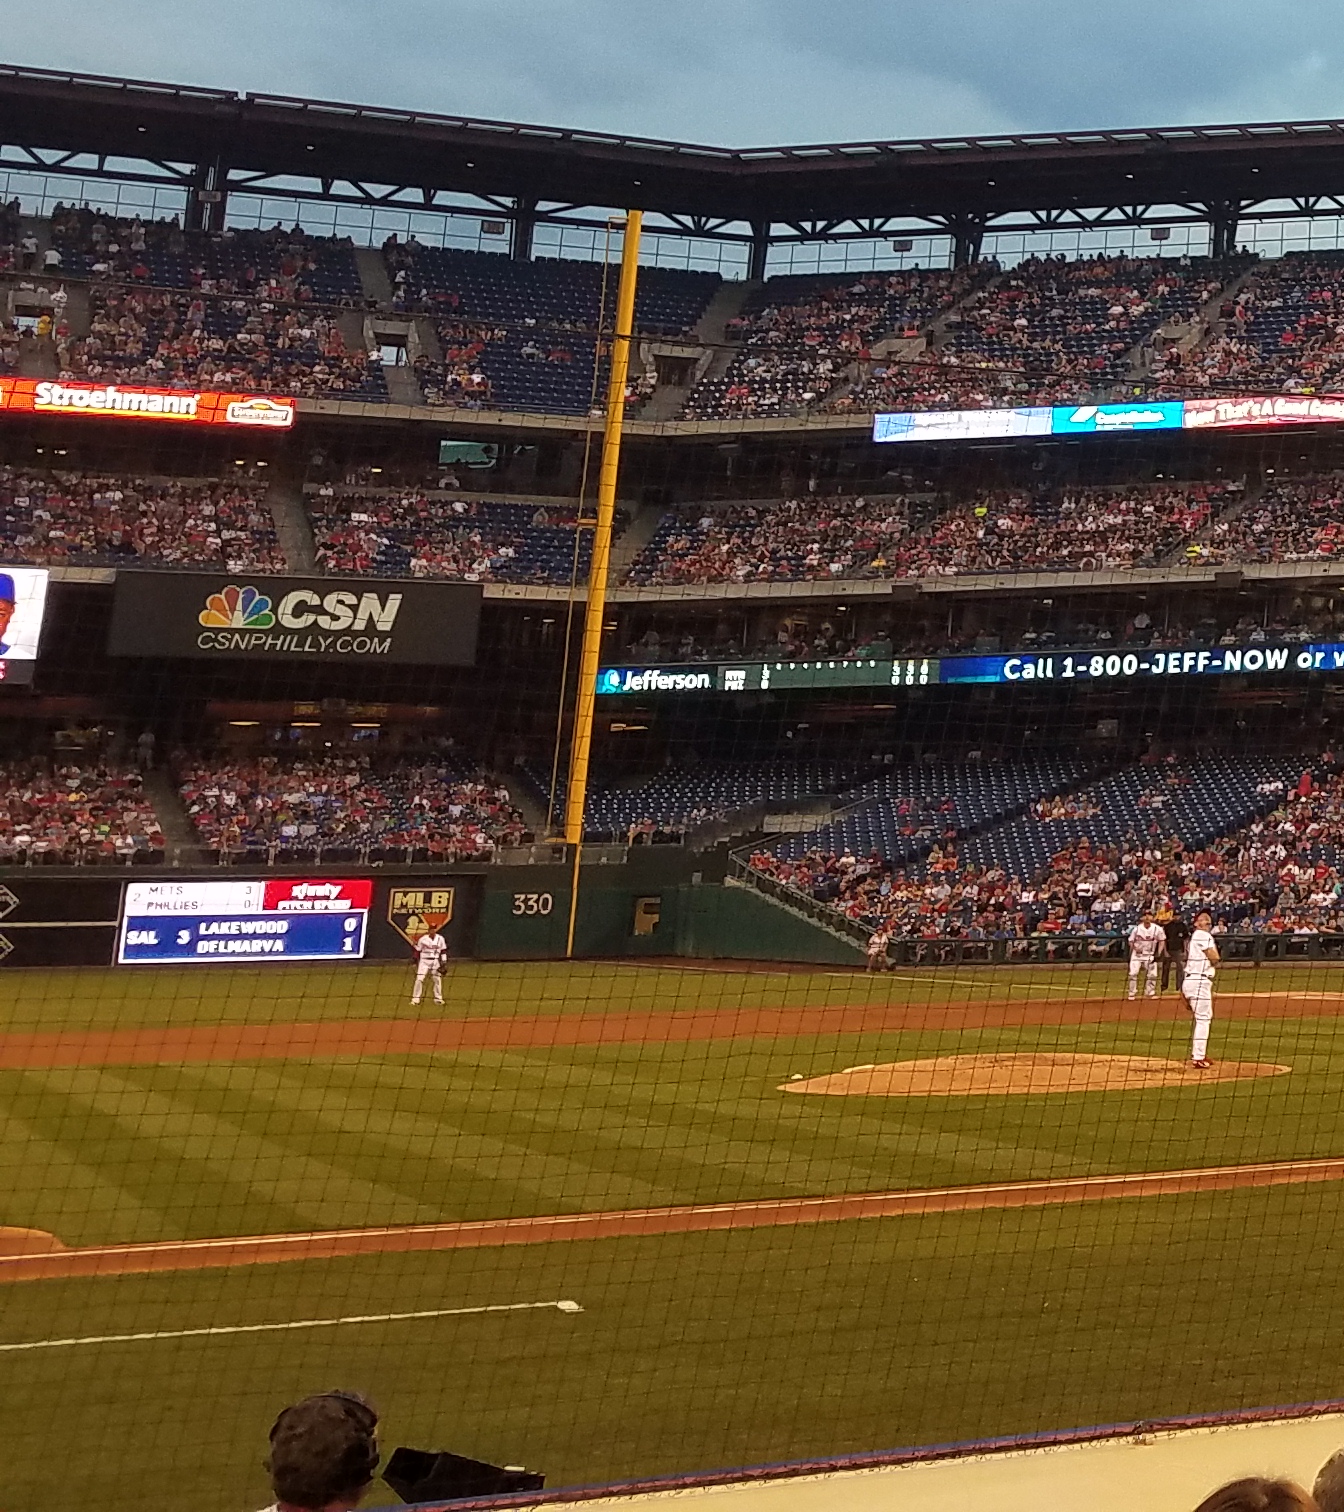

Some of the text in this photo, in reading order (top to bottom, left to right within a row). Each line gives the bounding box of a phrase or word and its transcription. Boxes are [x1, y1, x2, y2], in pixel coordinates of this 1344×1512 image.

[34, 381, 199, 415] Stroehmann
[277, 589, 402, 632] CSN
[197, 631, 391, 655] CSNPHILLY.COM
[1003, 656, 1054, 681] Call
[1061, 648, 1289, 679] 1-800-JEFF-NOW
[1297, 646, 1326, 669] or
[622, 670, 710, 692] Jefferson
[149, 885, 184, 896] METS
[393, 891, 450, 909] MLB
[146, 900, 199, 911] PHILLIES
[512, 892, 553, 916] 330
[199, 917, 357, 936] LAKEWOOD 0
[126, 929, 192, 945] SAL 3
[196, 937, 353, 954] DELMARVA 1
